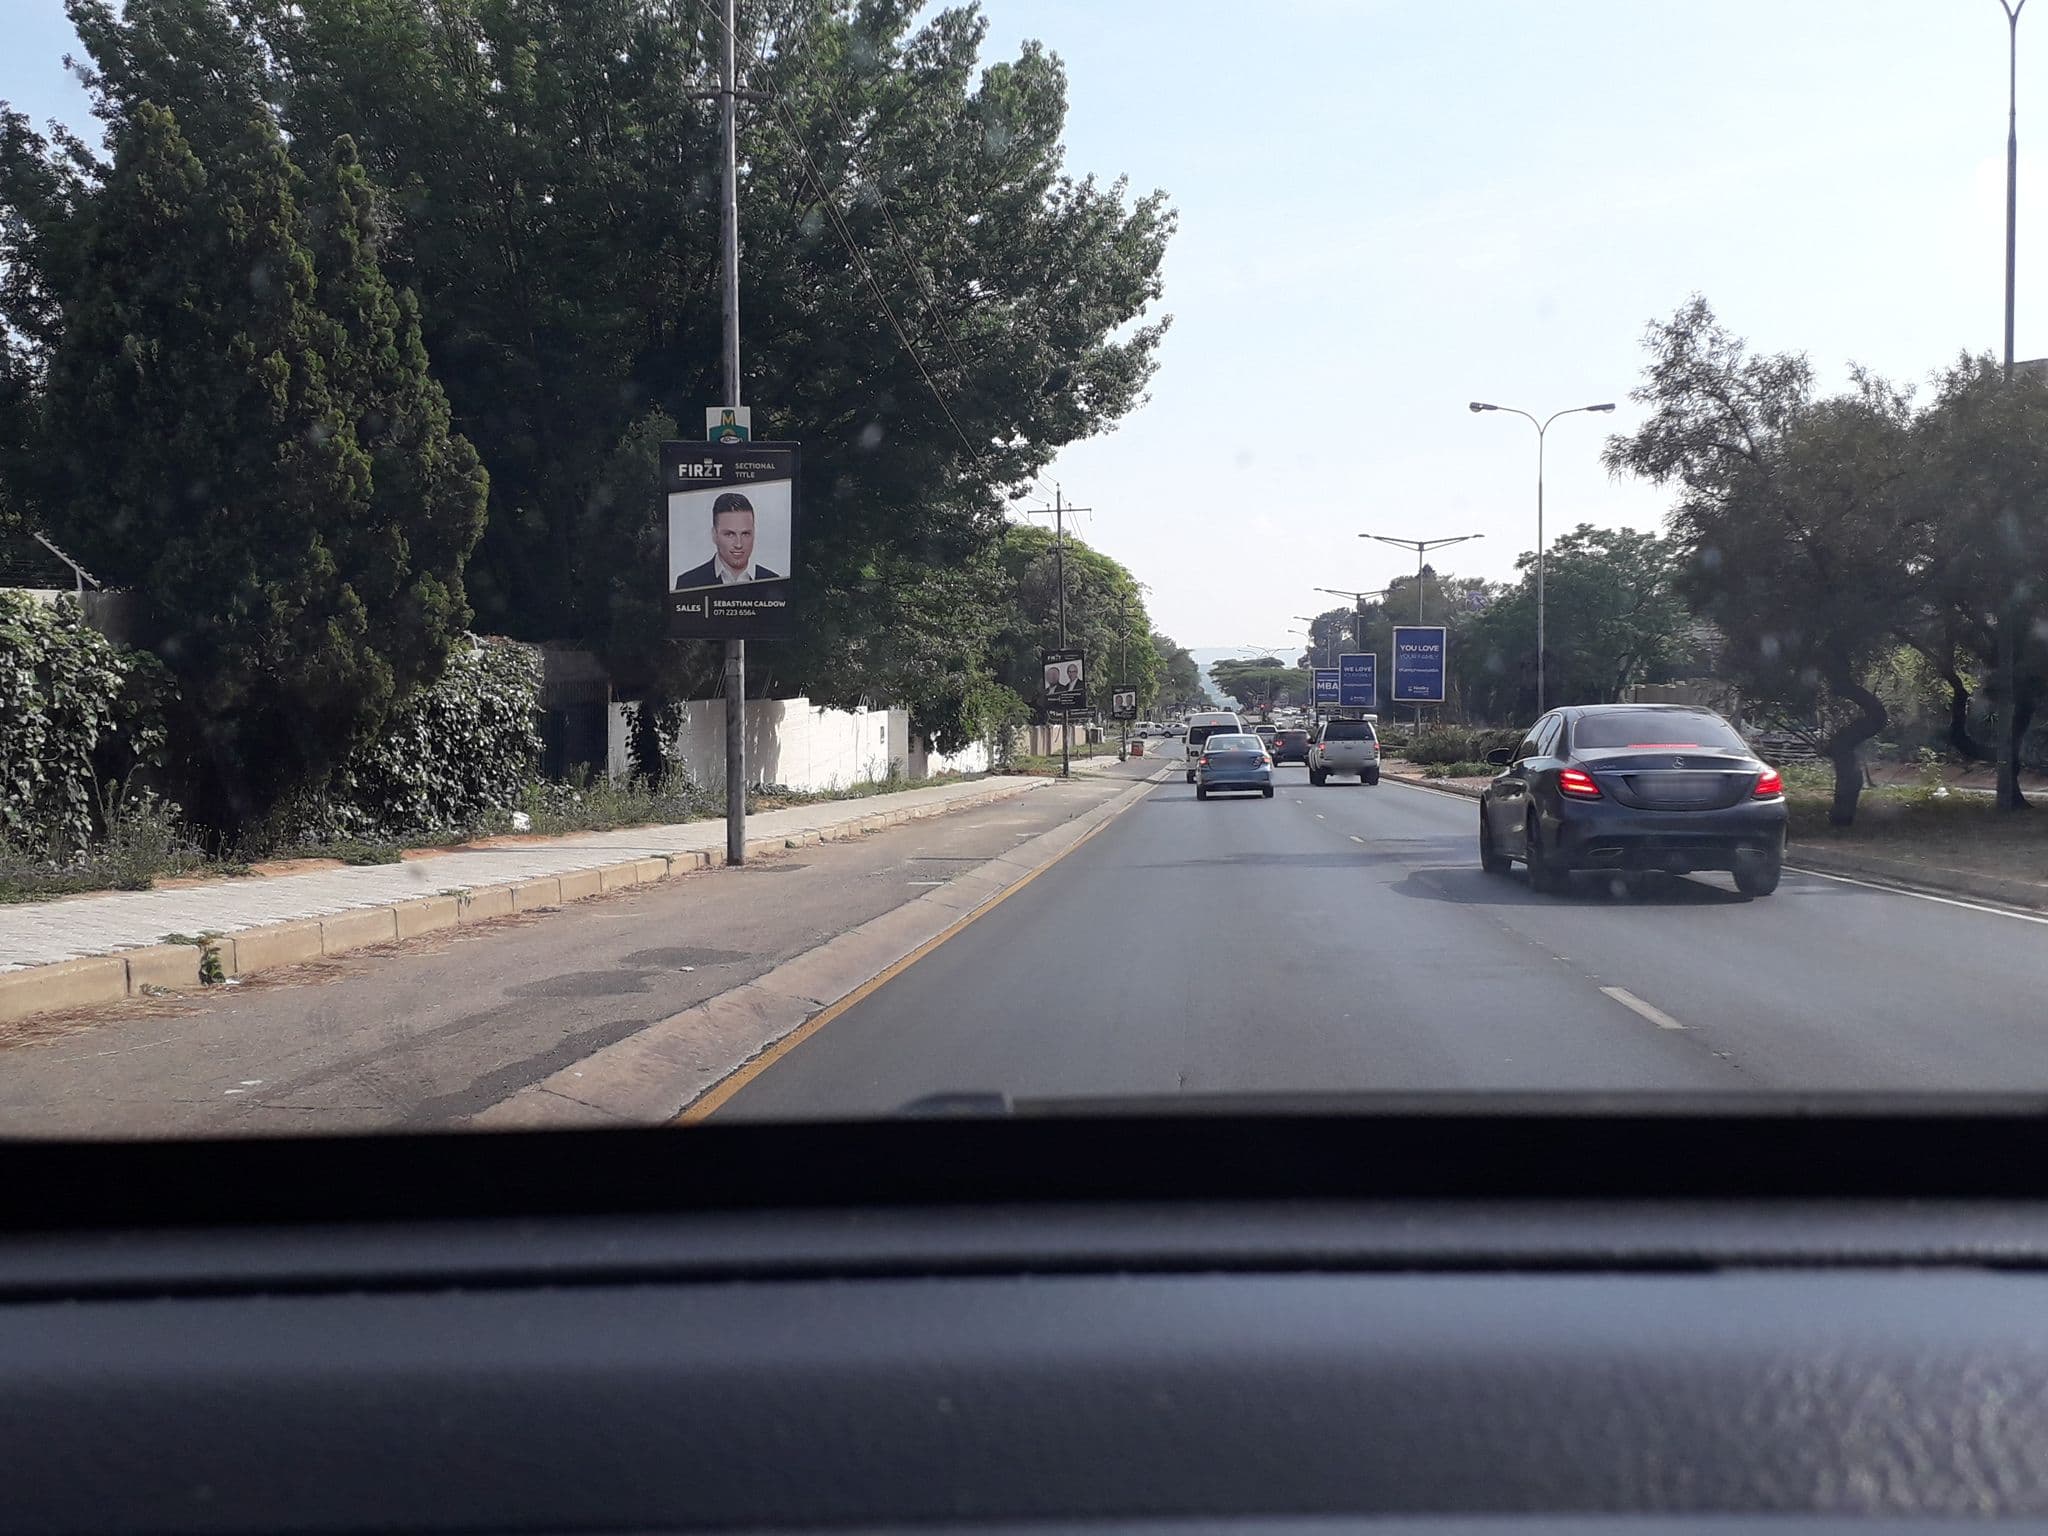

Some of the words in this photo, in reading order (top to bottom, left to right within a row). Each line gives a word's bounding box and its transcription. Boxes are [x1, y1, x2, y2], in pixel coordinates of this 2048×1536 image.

[678, 463, 722, 477] FIRZT
[676, 604, 701, 612] SALES
[1317, 682, 1339, 690] MBA
